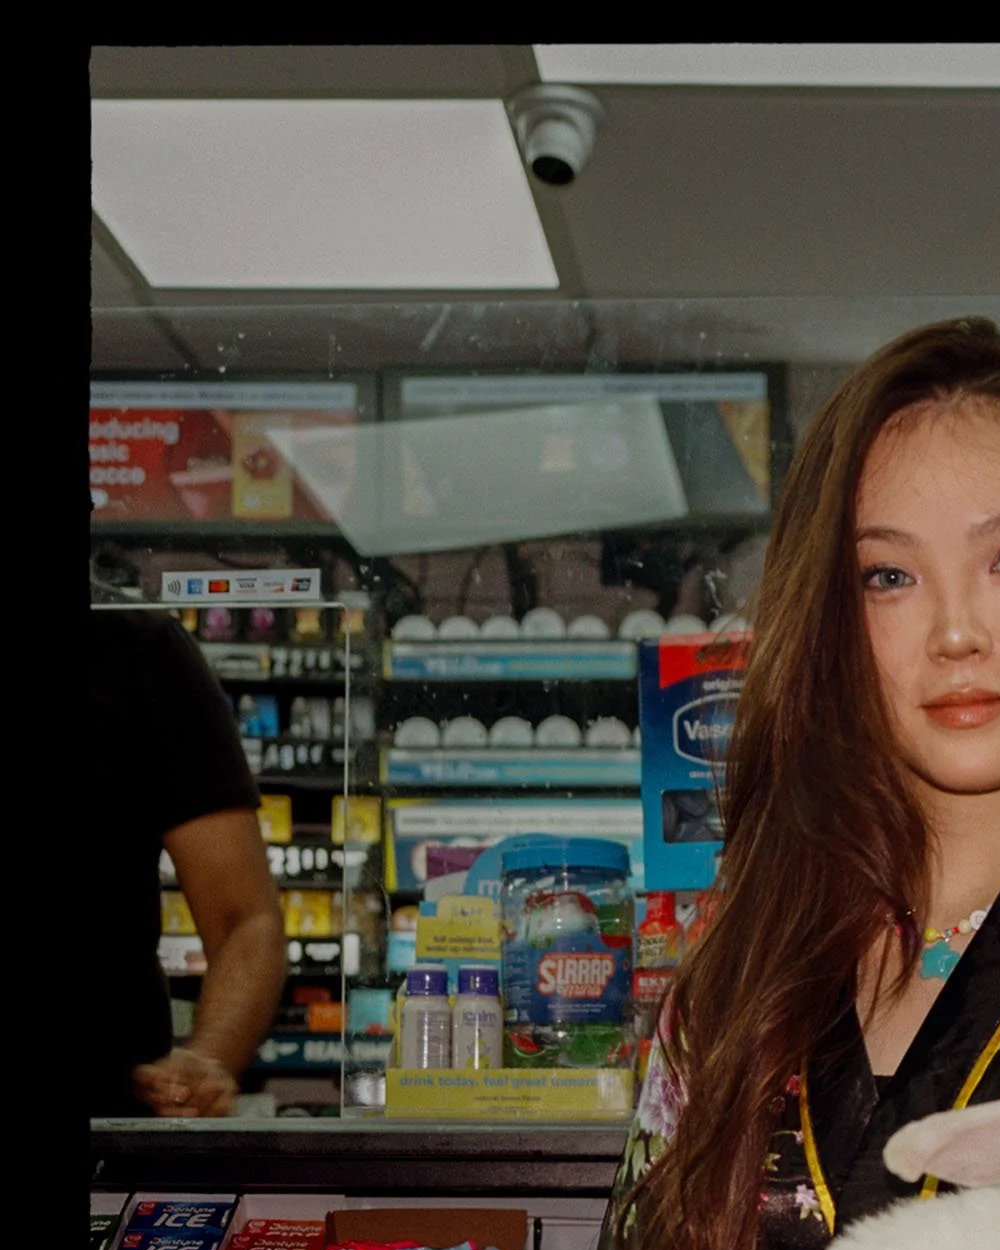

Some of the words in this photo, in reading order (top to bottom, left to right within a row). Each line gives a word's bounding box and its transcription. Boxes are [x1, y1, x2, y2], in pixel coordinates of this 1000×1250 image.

[399, 1073, 434, 1087] drink
[437, 1074, 479, 1089] today,
[483, 1074, 509, 1087] feel
[512, 1076, 547, 1089] great
[162, 1203, 217, 1215] Dentyne
[153, 1212, 213, 1228] ICE
[268, 1223, 322, 1233] Dentyne
[149, 1236, 205, 1248] Dentyne
[253, 1239, 309, 1249] Dentyne
